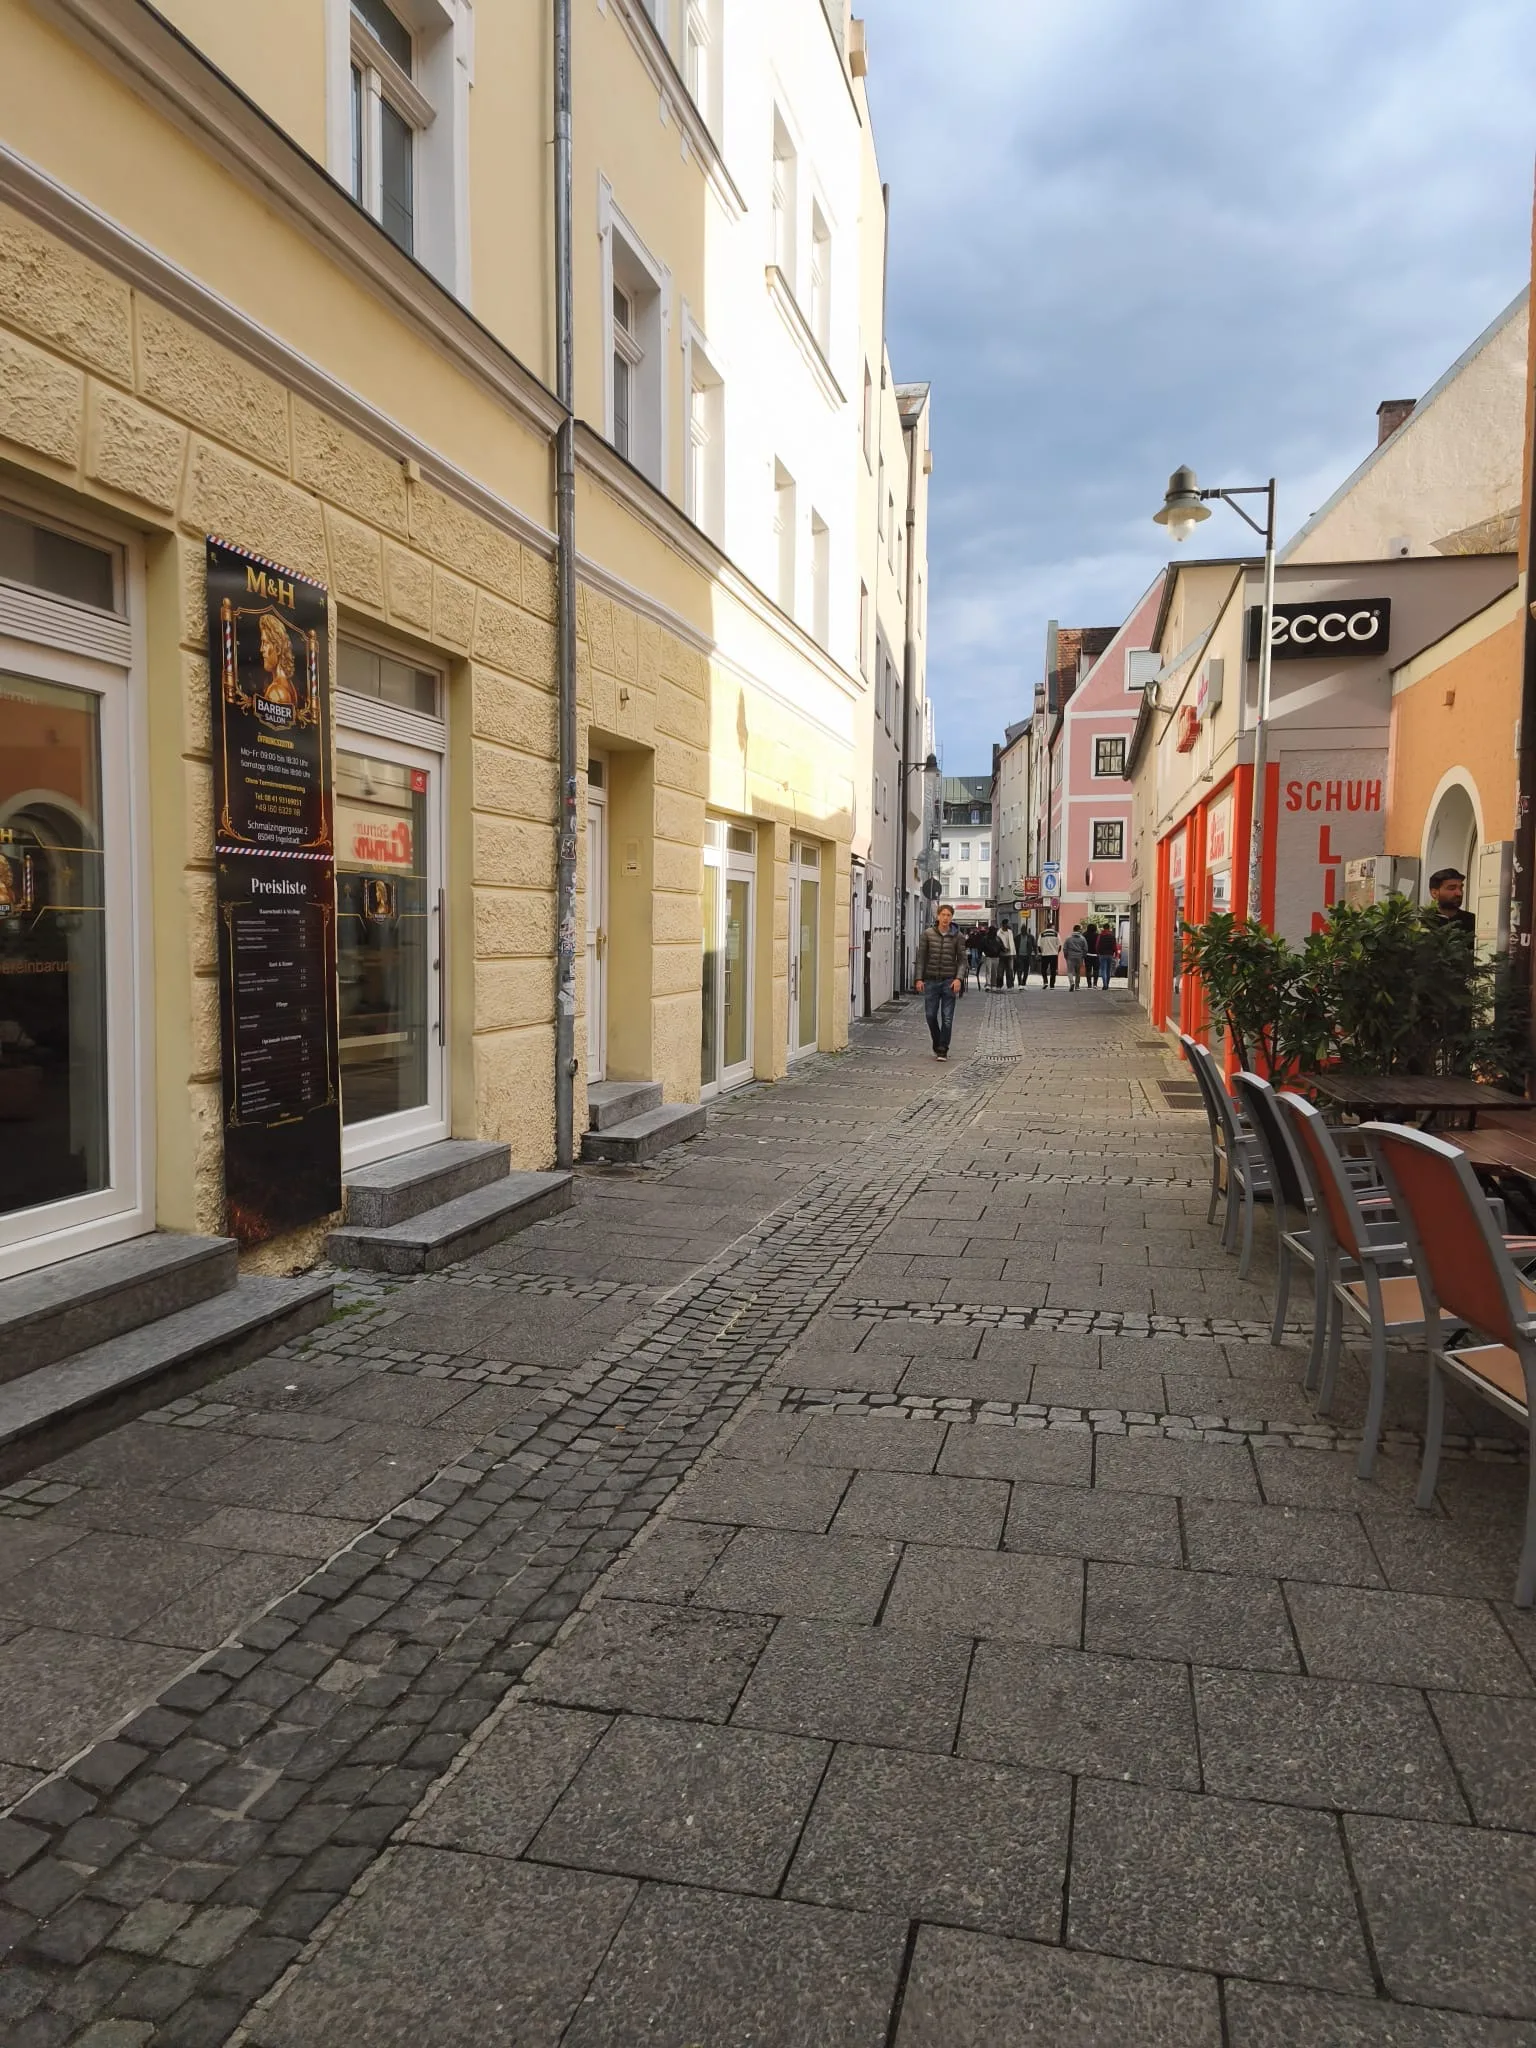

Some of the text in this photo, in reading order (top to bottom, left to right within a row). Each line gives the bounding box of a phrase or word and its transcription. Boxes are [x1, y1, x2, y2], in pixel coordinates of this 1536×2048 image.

[246, 565, 295, 609] M&H
[1271, 611, 1379, 645] ecco
[257, 699, 292, 718] BARBER
[264, 713, 286, 724] SALON
[1285, 779, 1382, 812] SCHUH
[251, 877, 307, 895] Preisliste
